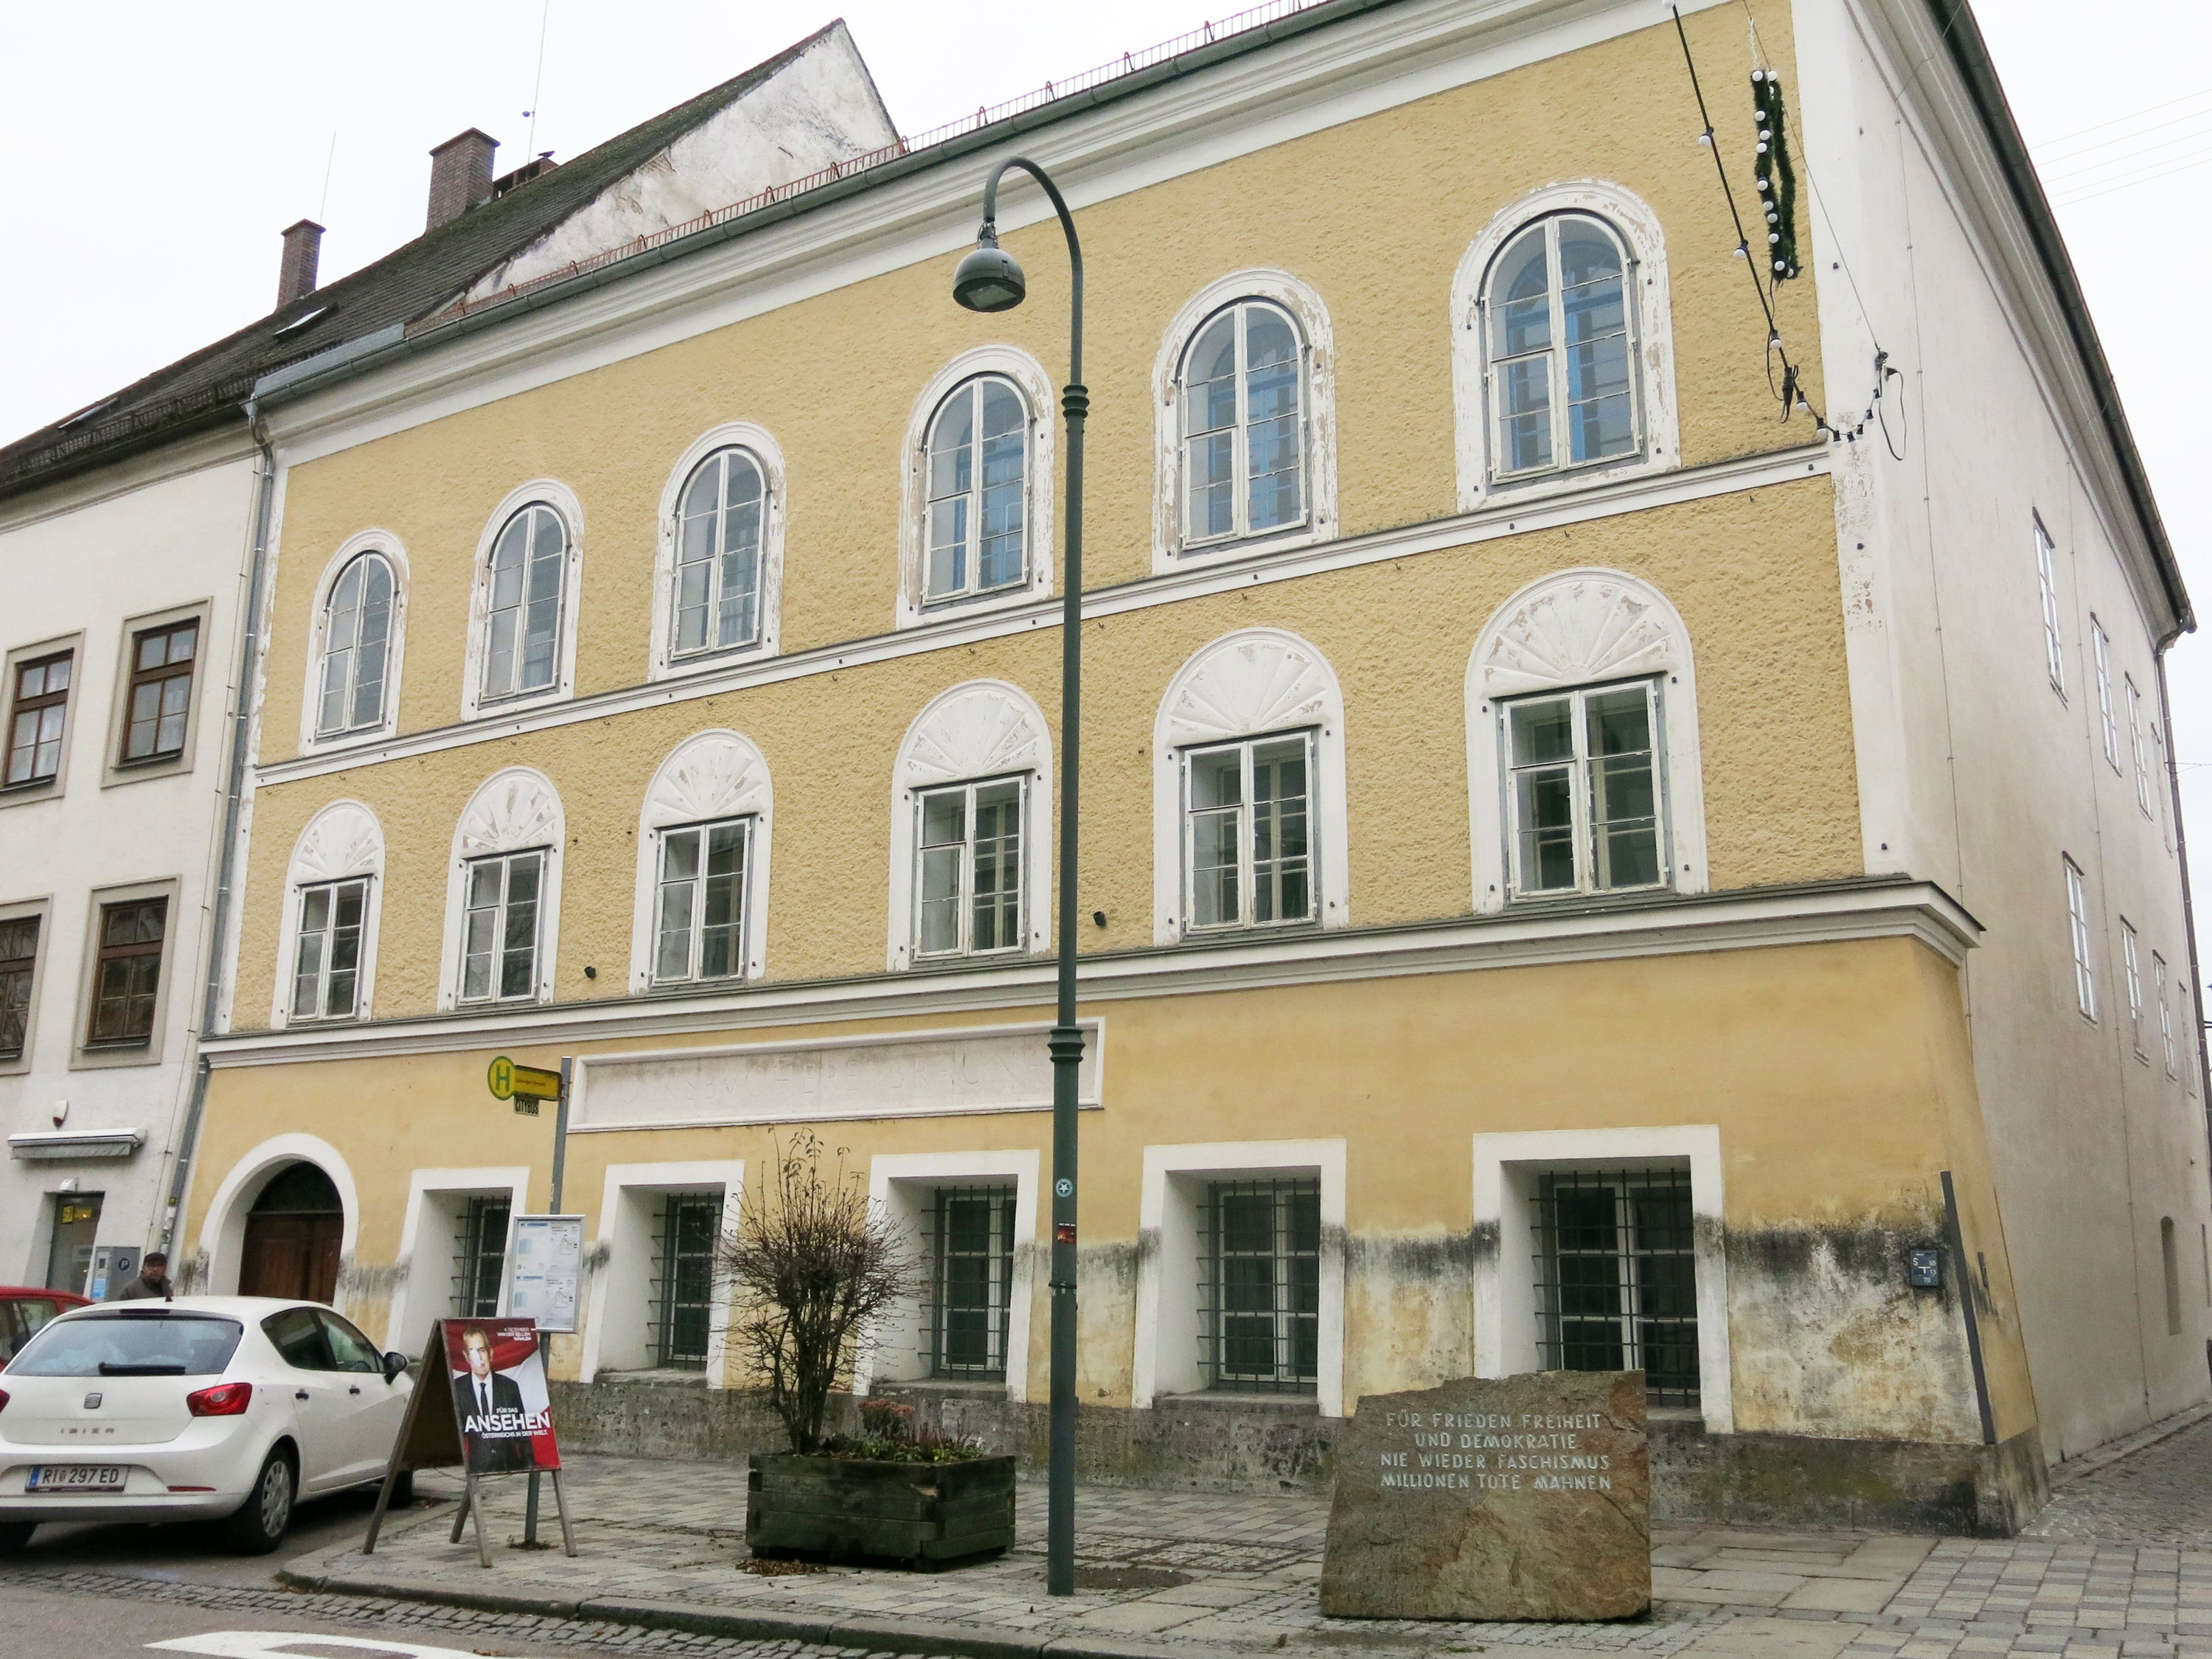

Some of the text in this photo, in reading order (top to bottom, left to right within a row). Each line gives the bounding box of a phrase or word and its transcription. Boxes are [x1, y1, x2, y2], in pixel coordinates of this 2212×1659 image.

[495, 1064, 511, 1093] H
[1913, 1257, 1919, 1266] S
[465, 1411, 551, 1433] ANSEHEN
[1386, 1409, 1601, 1429] FÜR FRIEDEN FREIHEIT
[1415, 1433, 1576, 1450] UND DEMOKRATIE
[1380, 1453, 1610, 1470] NIE WIEDER FASCHISMUS
[42, 1468, 119, 1484] RI 297 ED
[1380, 1473, 1611, 1490] MILLIONEN TOTE MAHNEN
